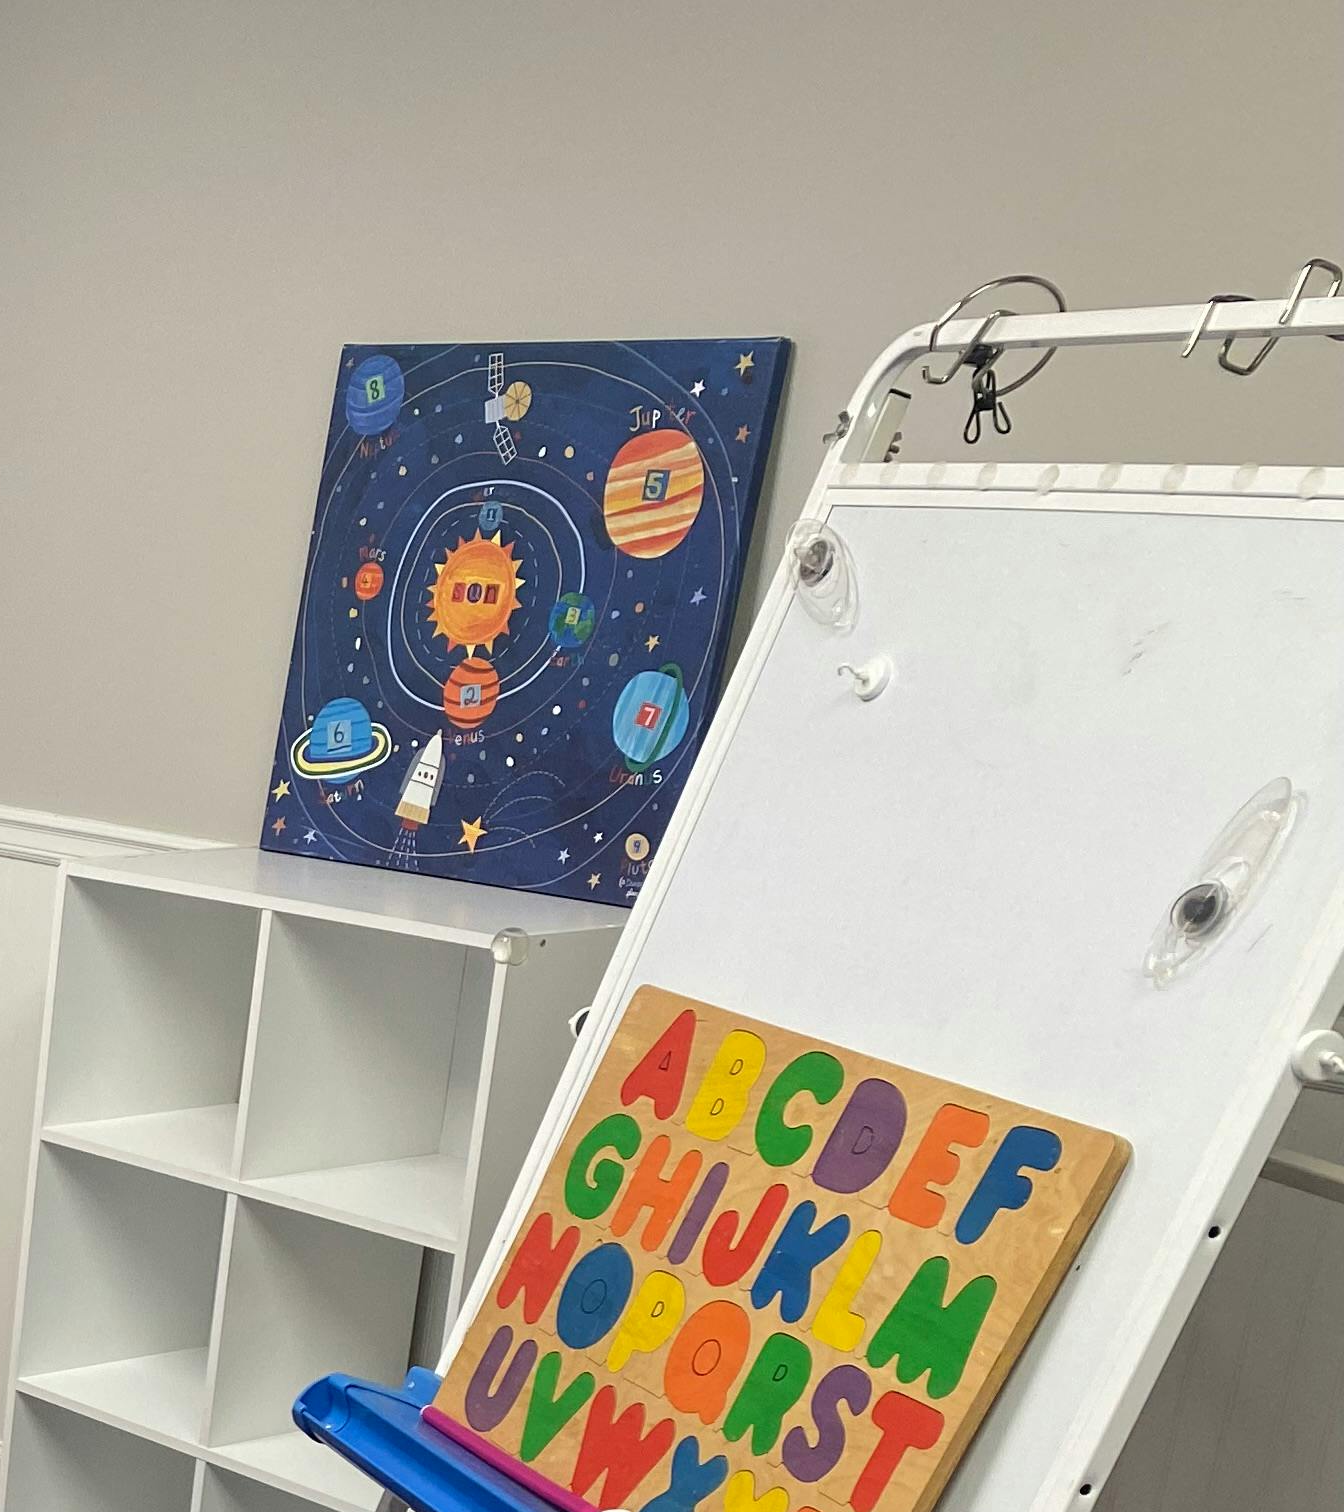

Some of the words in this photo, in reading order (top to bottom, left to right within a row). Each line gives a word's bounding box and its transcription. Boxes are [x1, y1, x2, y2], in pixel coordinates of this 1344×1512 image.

[370, 379, 380, 400] 8
[628, 402, 697, 431] Jupter
[645, 471, 664, 499] 5
[464, 686, 479, 706] 2
[644, 706, 656, 726] 7
[333, 722, 345, 744] 6
[448, 729, 485, 746] enus
[609, 764, 663, 786] Urans
[620, 1009, 696, 1120] A
[684, 1029, 767, 1142] B
[754, 1051, 844, 1167] C
[811, 1077, 908, 1194] D
[888, 1103, 990, 1228] E
[955, 1125, 1062, 1244] F
[564, 1114, 642, 1220] G
[610, 1135, 702, 1252] H
[667, 1162, 729, 1265] I
[702, 1183, 789, 1287] J
[750, 1201, 851, 1324] K
[811, 1229, 883, 1353] L
[866, 1256, 997, 1399] M
[497, 1213, 581, 1324] N
[556, 1243, 634, 1349] O
[606, 1270, 686, 1373] P
[663, 1300, 751, 1425] Q
[722, 1333, 813, 1456] R
[781, 1364, 872, 1483] S
[464, 1326, 536, 1432] U
[519, 1352, 596, 1462] V
[569, 1385, 676, 1512] W
